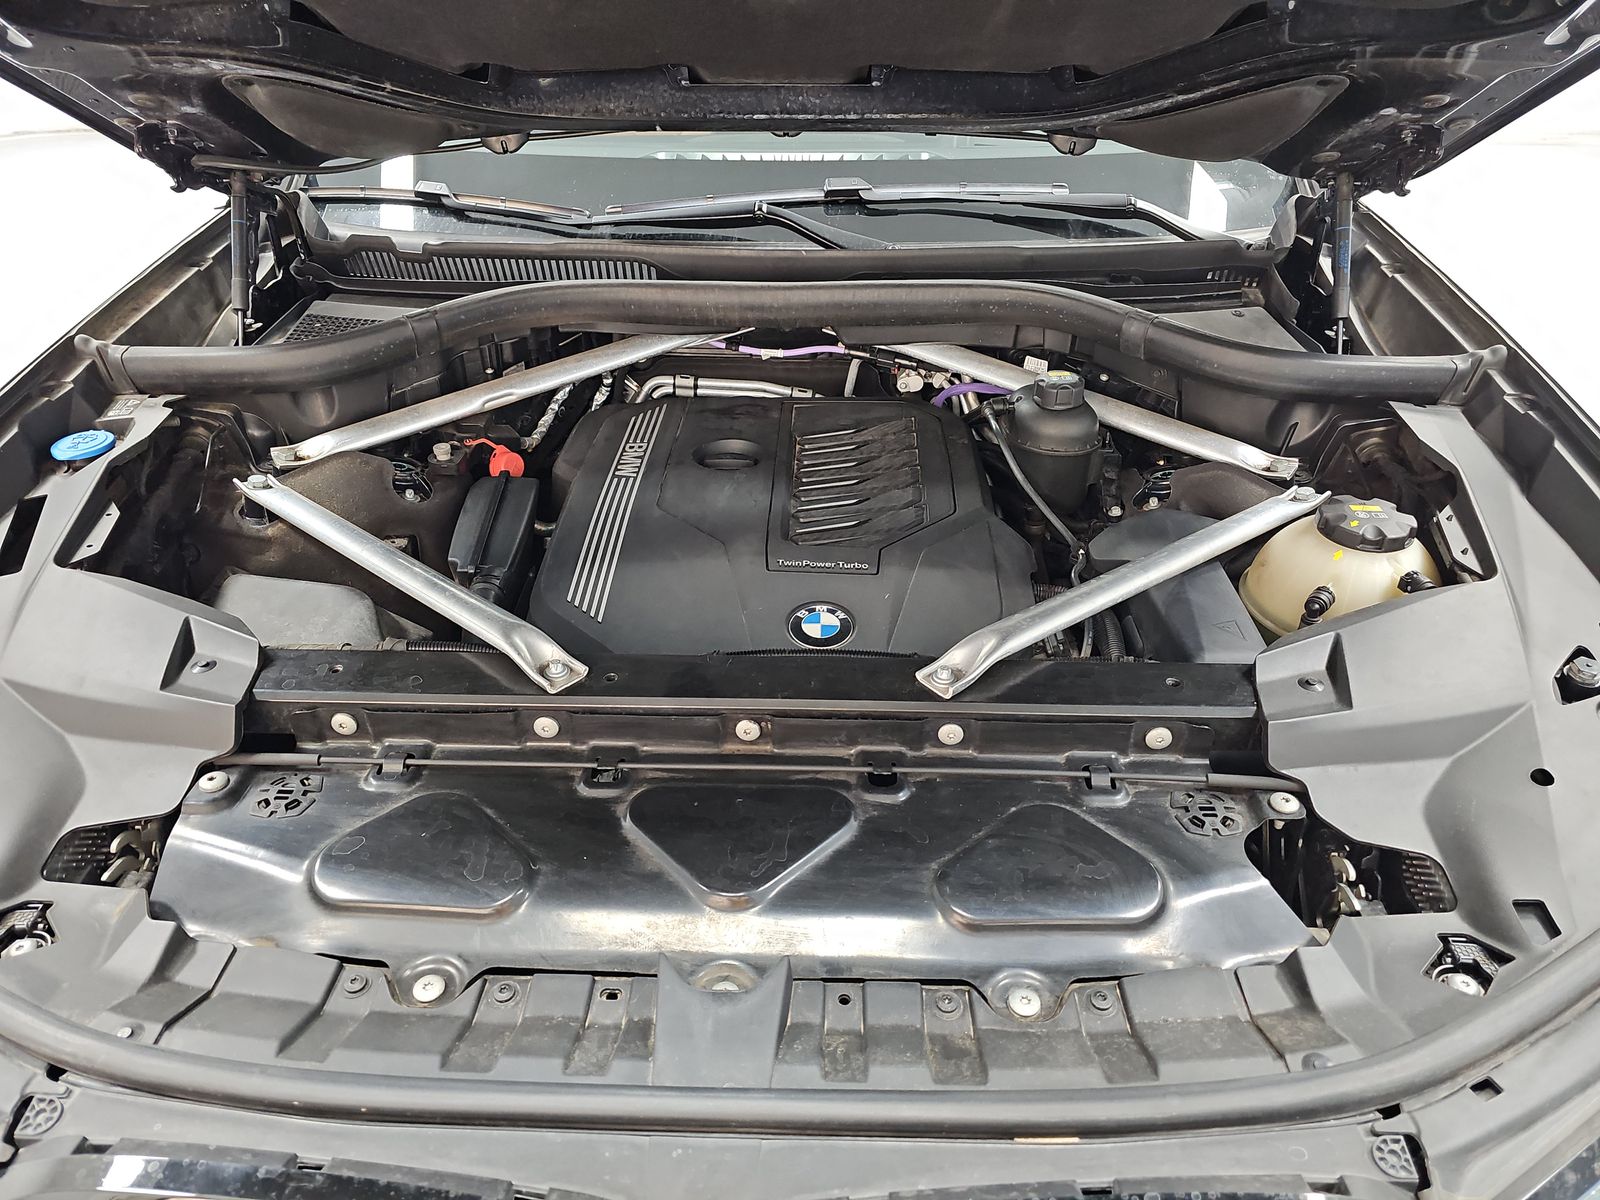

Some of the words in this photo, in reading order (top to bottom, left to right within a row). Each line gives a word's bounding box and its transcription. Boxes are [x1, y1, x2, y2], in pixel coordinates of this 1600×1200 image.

[614, 442, 648, 477] BMW
[837, 561, 869, 570] Turbo
[796, 605, 848, 619] BMW
